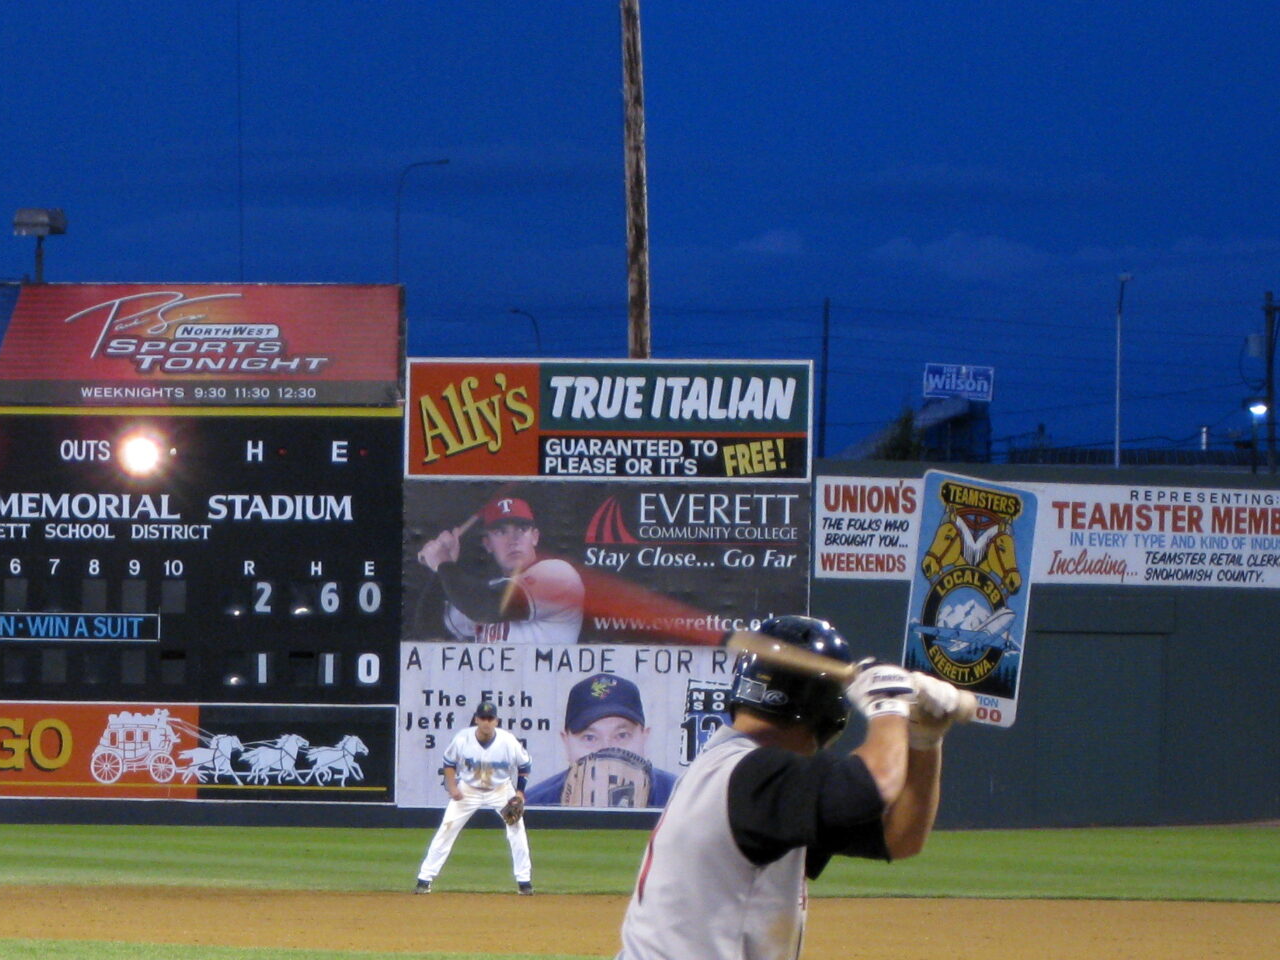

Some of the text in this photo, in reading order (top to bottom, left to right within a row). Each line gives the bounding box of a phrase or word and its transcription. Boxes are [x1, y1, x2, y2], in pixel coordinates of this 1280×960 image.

[106, 339, 282, 354] SPORTS
[135, 355, 328, 371] TONIGHT
[81, 387, 317, 398] WEEKNIGHTS 9:30 11:30 12:30
[928, 373, 988, 392] Wilson
[550, 376, 796, 420] TRUE ITALIAN
[420, 372, 535, 463] Alfy's
[60, 440, 111, 461] OUTS
[246, 440, 263, 462] H
[331, 440, 349, 462] E
[545, 439, 718, 457] GUARANTEED TO
[723, 438, 788, 477] FREE!
[545, 457, 698, 475] PLEASE OR IT'S
[823, 480, 917, 514] UNION'S
[949, 485, 1016, 514] TEAMSTERS
[1130, 490, 1280, 506] REPRESENTING:
[207, 495, 354, 521] STADIUM
[639, 493, 799, 525] EVERETT
[1052, 501, 1204, 534] TEAMSTER
[44, 524, 116, 539] SCHOOL
[131, 525, 212, 540] DISTRICT
[639, 526, 799, 540] COMMUNITY COLLEGE
[822, 517, 910, 533] THE FOLKS WHO
[824, 533, 909, 548] BROUGHT YOU...
[1070, 532, 1247, 550] IN EVERY TYPE AND KIND OF
[10, 559, 21, 574] 6
[49, 559, 60, 574] 7
[89, 560, 100, 575] 8
[129, 560, 140, 575] 9
[163, 560, 183, 576] 10
[244, 561, 255, 575] R
[310, 561, 322, 576] H
[364, 561, 375, 576] E
[584, 547, 797, 572] Stay Close... Go Far
[821, 552, 907, 573] WEEKENDS
[1047, 548, 1244, 583] Including... TEAMSTER RETAIL
[936, 570, 982, 597] LOCAL
[1144, 568, 1265, 583] SNOHOMISH COUNTY.
[254, 582, 272, 613] 2
[320, 582, 340, 612] 6
[358, 581, 381, 613] 0
[73, 617, 90, 637] A
[93, 617, 144, 638] SUIT
[357, 653, 381, 684] 0
[406, 646, 422, 671] A
[441, 647, 516, 672] FACE
[534, 648, 616, 673] MADE
[635, 649, 693, 674] FOR
[422, 690, 533, 708] The Fish
[405, 712, 455, 731] Jeff
